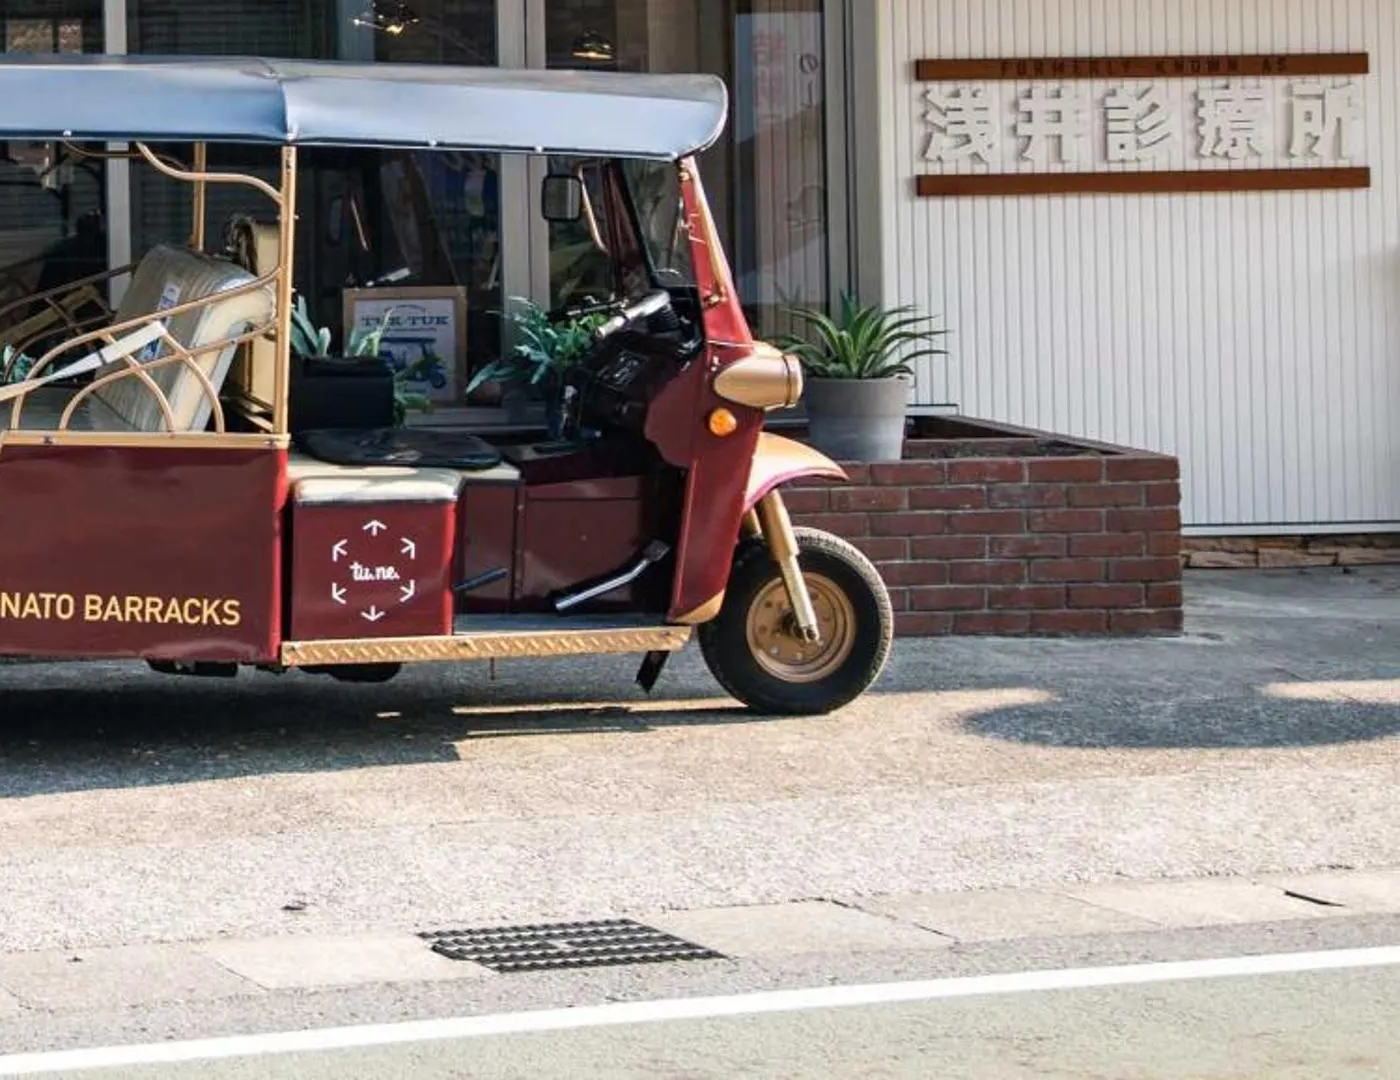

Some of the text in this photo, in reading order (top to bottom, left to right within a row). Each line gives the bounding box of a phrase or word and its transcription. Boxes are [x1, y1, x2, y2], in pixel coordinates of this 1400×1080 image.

[1002, 56, 1290, 78] FORMERLY KNOWN AS
[83, 595, 241, 626] BARRACKS
